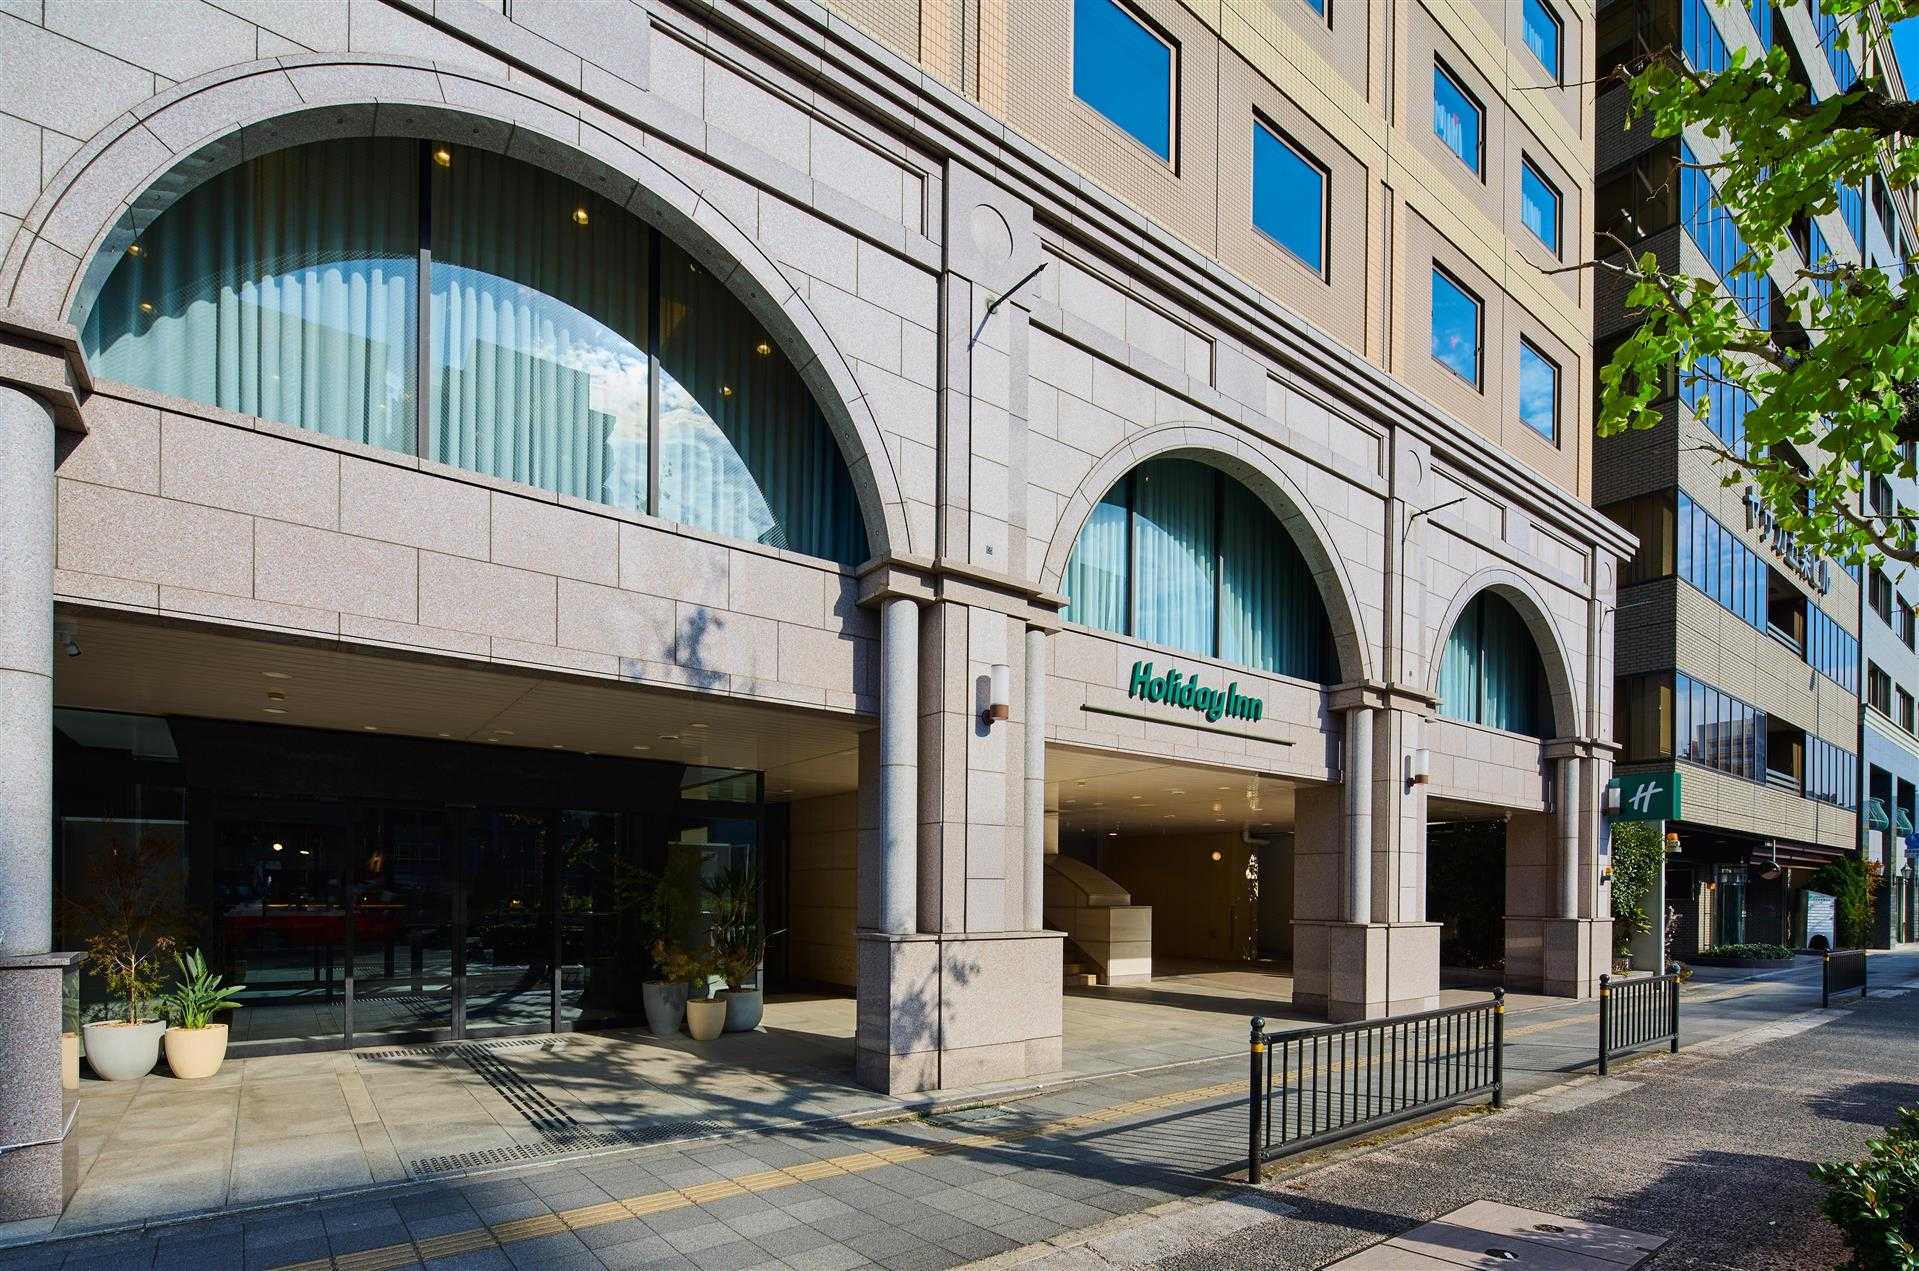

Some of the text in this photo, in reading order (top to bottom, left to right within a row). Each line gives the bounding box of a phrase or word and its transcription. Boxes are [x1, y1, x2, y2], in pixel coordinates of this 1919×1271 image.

[1128, 661, 1263, 723] Holiday Inn
[1629, 781, 1664, 813] H
